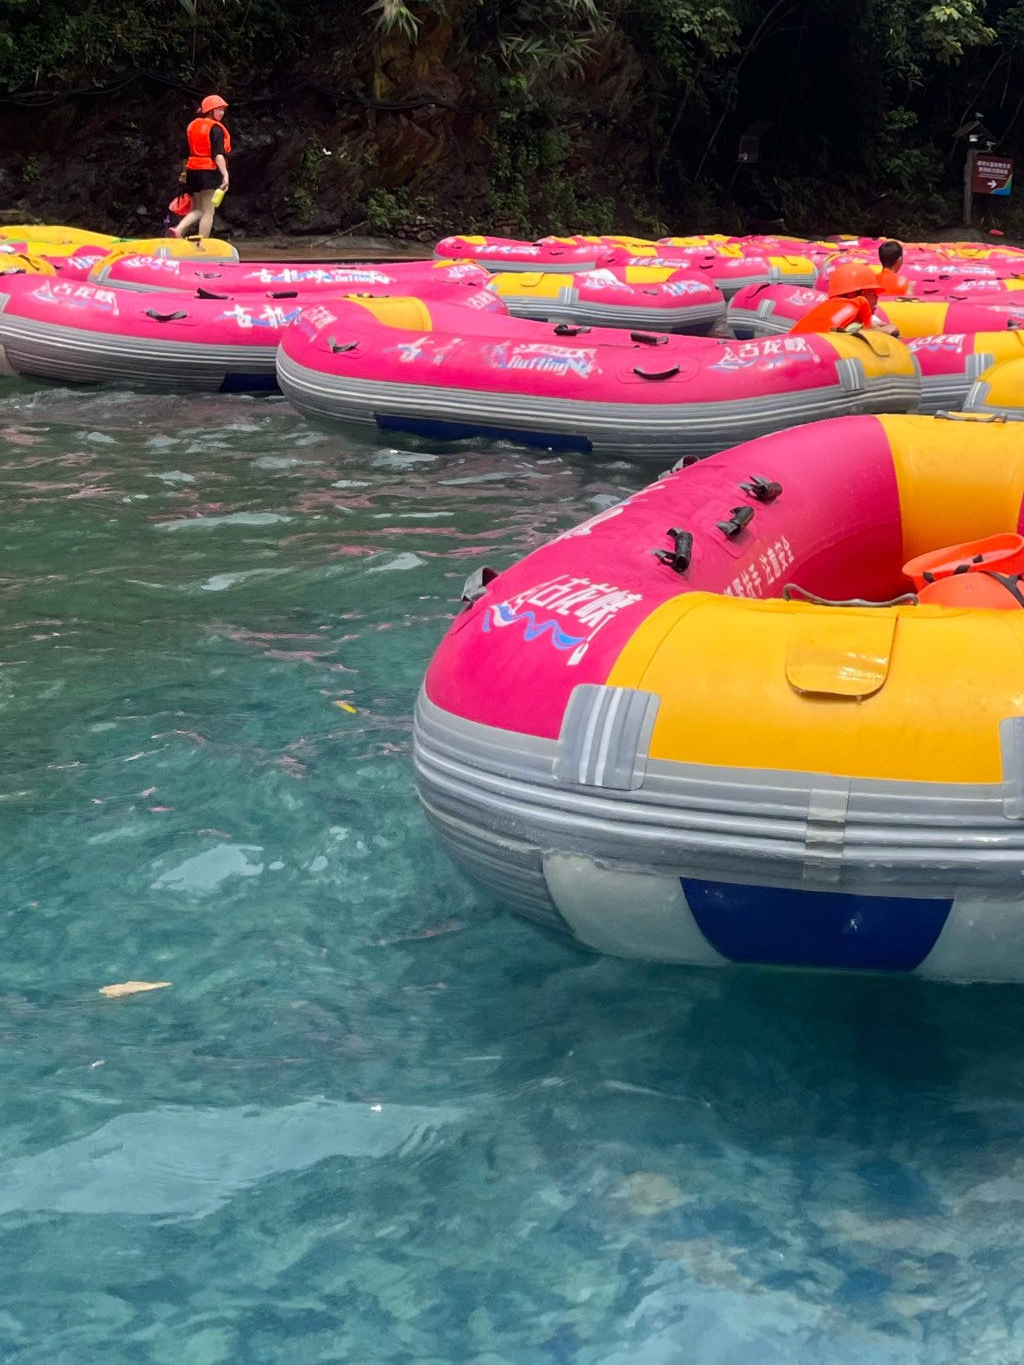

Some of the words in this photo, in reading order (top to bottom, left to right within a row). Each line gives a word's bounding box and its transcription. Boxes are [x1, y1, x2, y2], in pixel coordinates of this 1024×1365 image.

[738, 336, 808, 357] 古龙峡
[528, 577, 644, 628] 古龙峡
